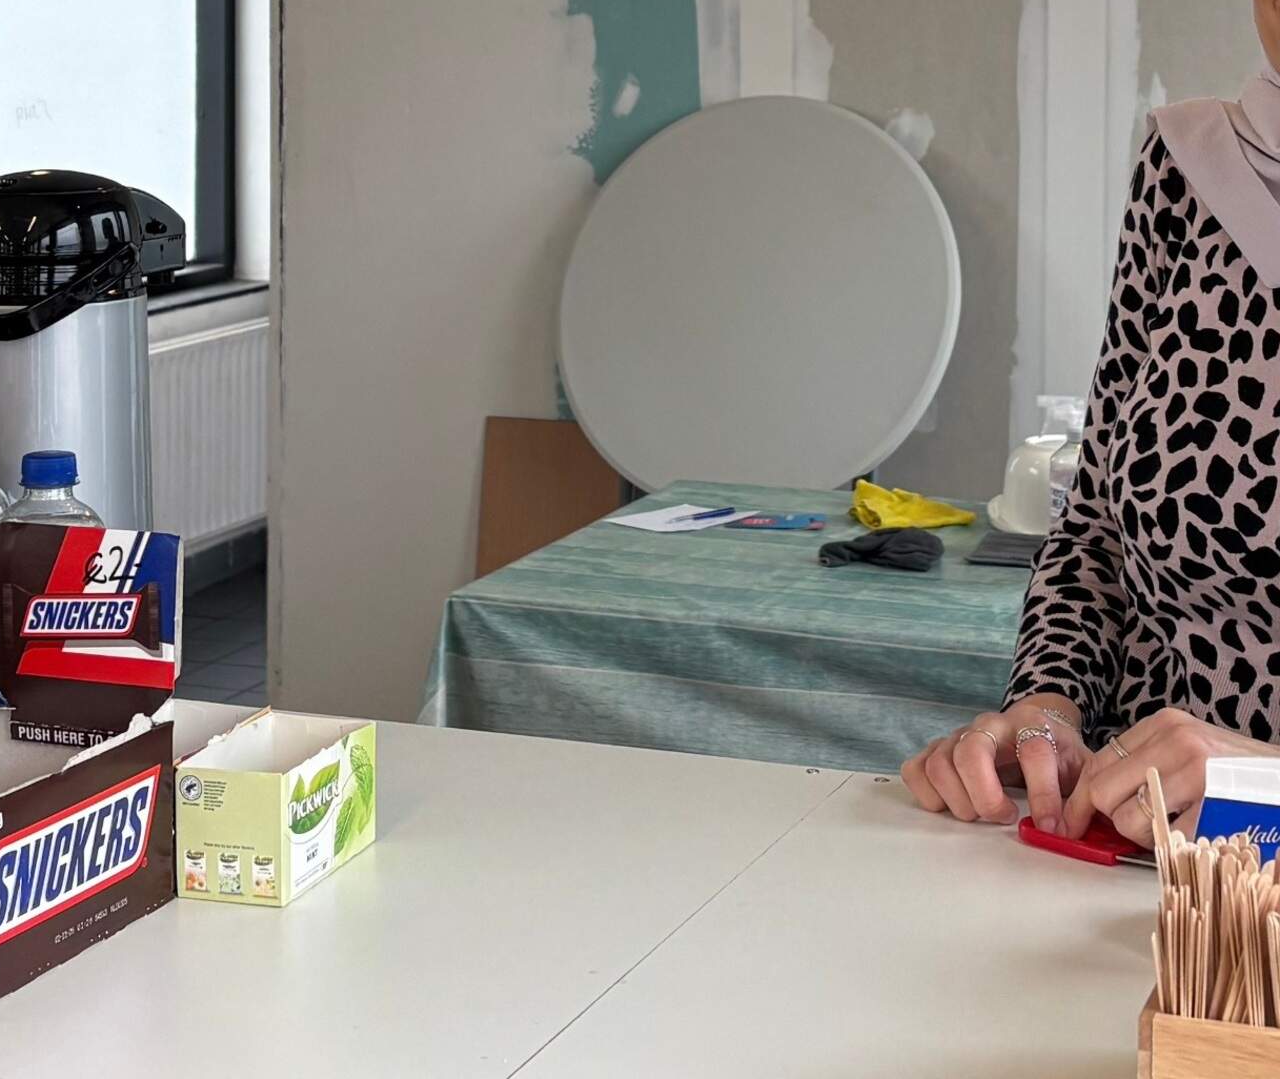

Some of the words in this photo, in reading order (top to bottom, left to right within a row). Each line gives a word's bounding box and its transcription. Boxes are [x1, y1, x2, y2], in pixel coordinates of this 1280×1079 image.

[27, 601, 134, 630] SNICKERS
[18, 725, 51, 741] PUSH
[54, 729, 85, 746] HERE
[89, 733, 104, 746] TO
[288, 780, 341, 825] PICKWICK
